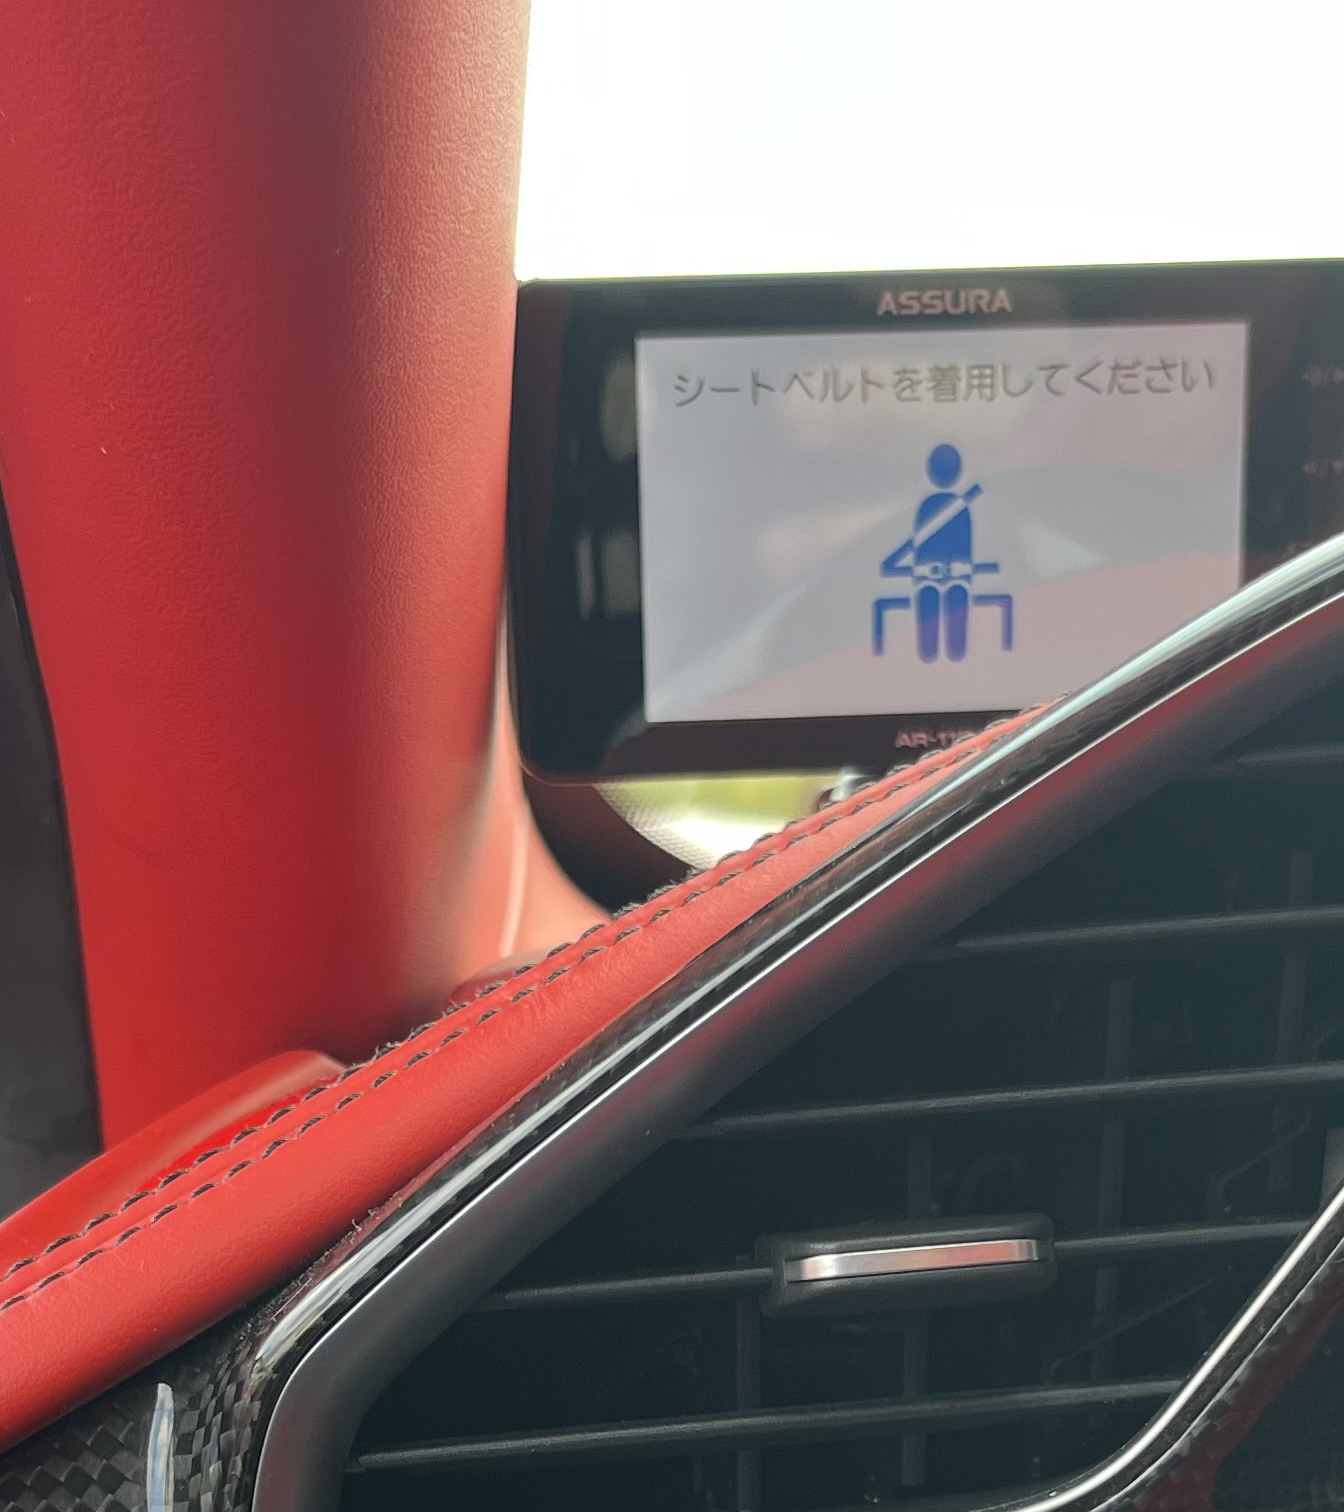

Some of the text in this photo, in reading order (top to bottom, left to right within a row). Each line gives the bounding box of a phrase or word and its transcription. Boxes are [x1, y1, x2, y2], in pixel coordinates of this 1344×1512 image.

[876, 288, 1013, 317] ASSURA
[671, 356, 1216, 408] シートベルトを着用してください
